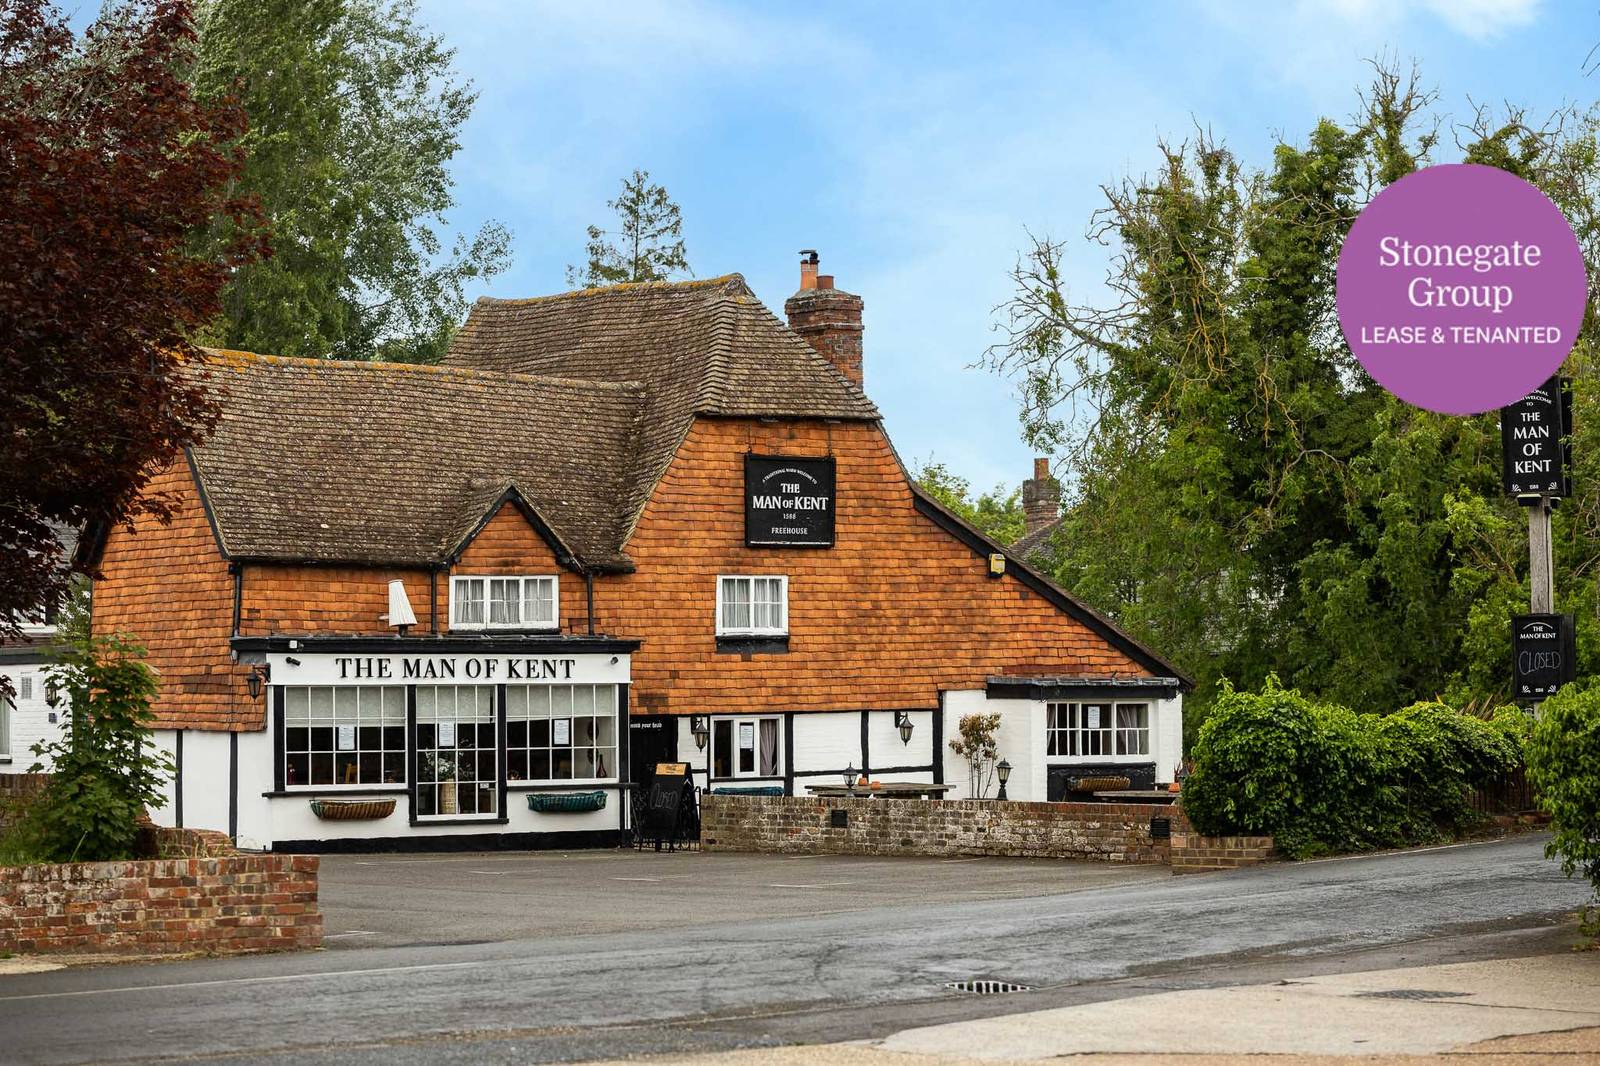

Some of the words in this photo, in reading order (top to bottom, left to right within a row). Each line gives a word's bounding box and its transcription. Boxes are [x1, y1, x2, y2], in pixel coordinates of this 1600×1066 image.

[1524, 395, 1552, 404] WELCOME
[1520, 412, 1541, 422] THE
[1514, 425, 1550, 440] MAN
[1522, 443, 1542, 456] OF
[1515, 460, 1552, 474] KENT
[780, 483, 800, 493] THE
[752, 495, 781, 509] MAN
[782, 499, 794, 509] OF
[794, 496, 829, 510] KENT
[771, 527, 808, 535] FREEHOUSE
[335, 657, 393, 679] THE
[401, 657, 457, 679] MAN
[465, 657, 499, 679] OF
[507, 658, 577, 680] KENT
[1518, 650, 1562, 676] CLOSED
